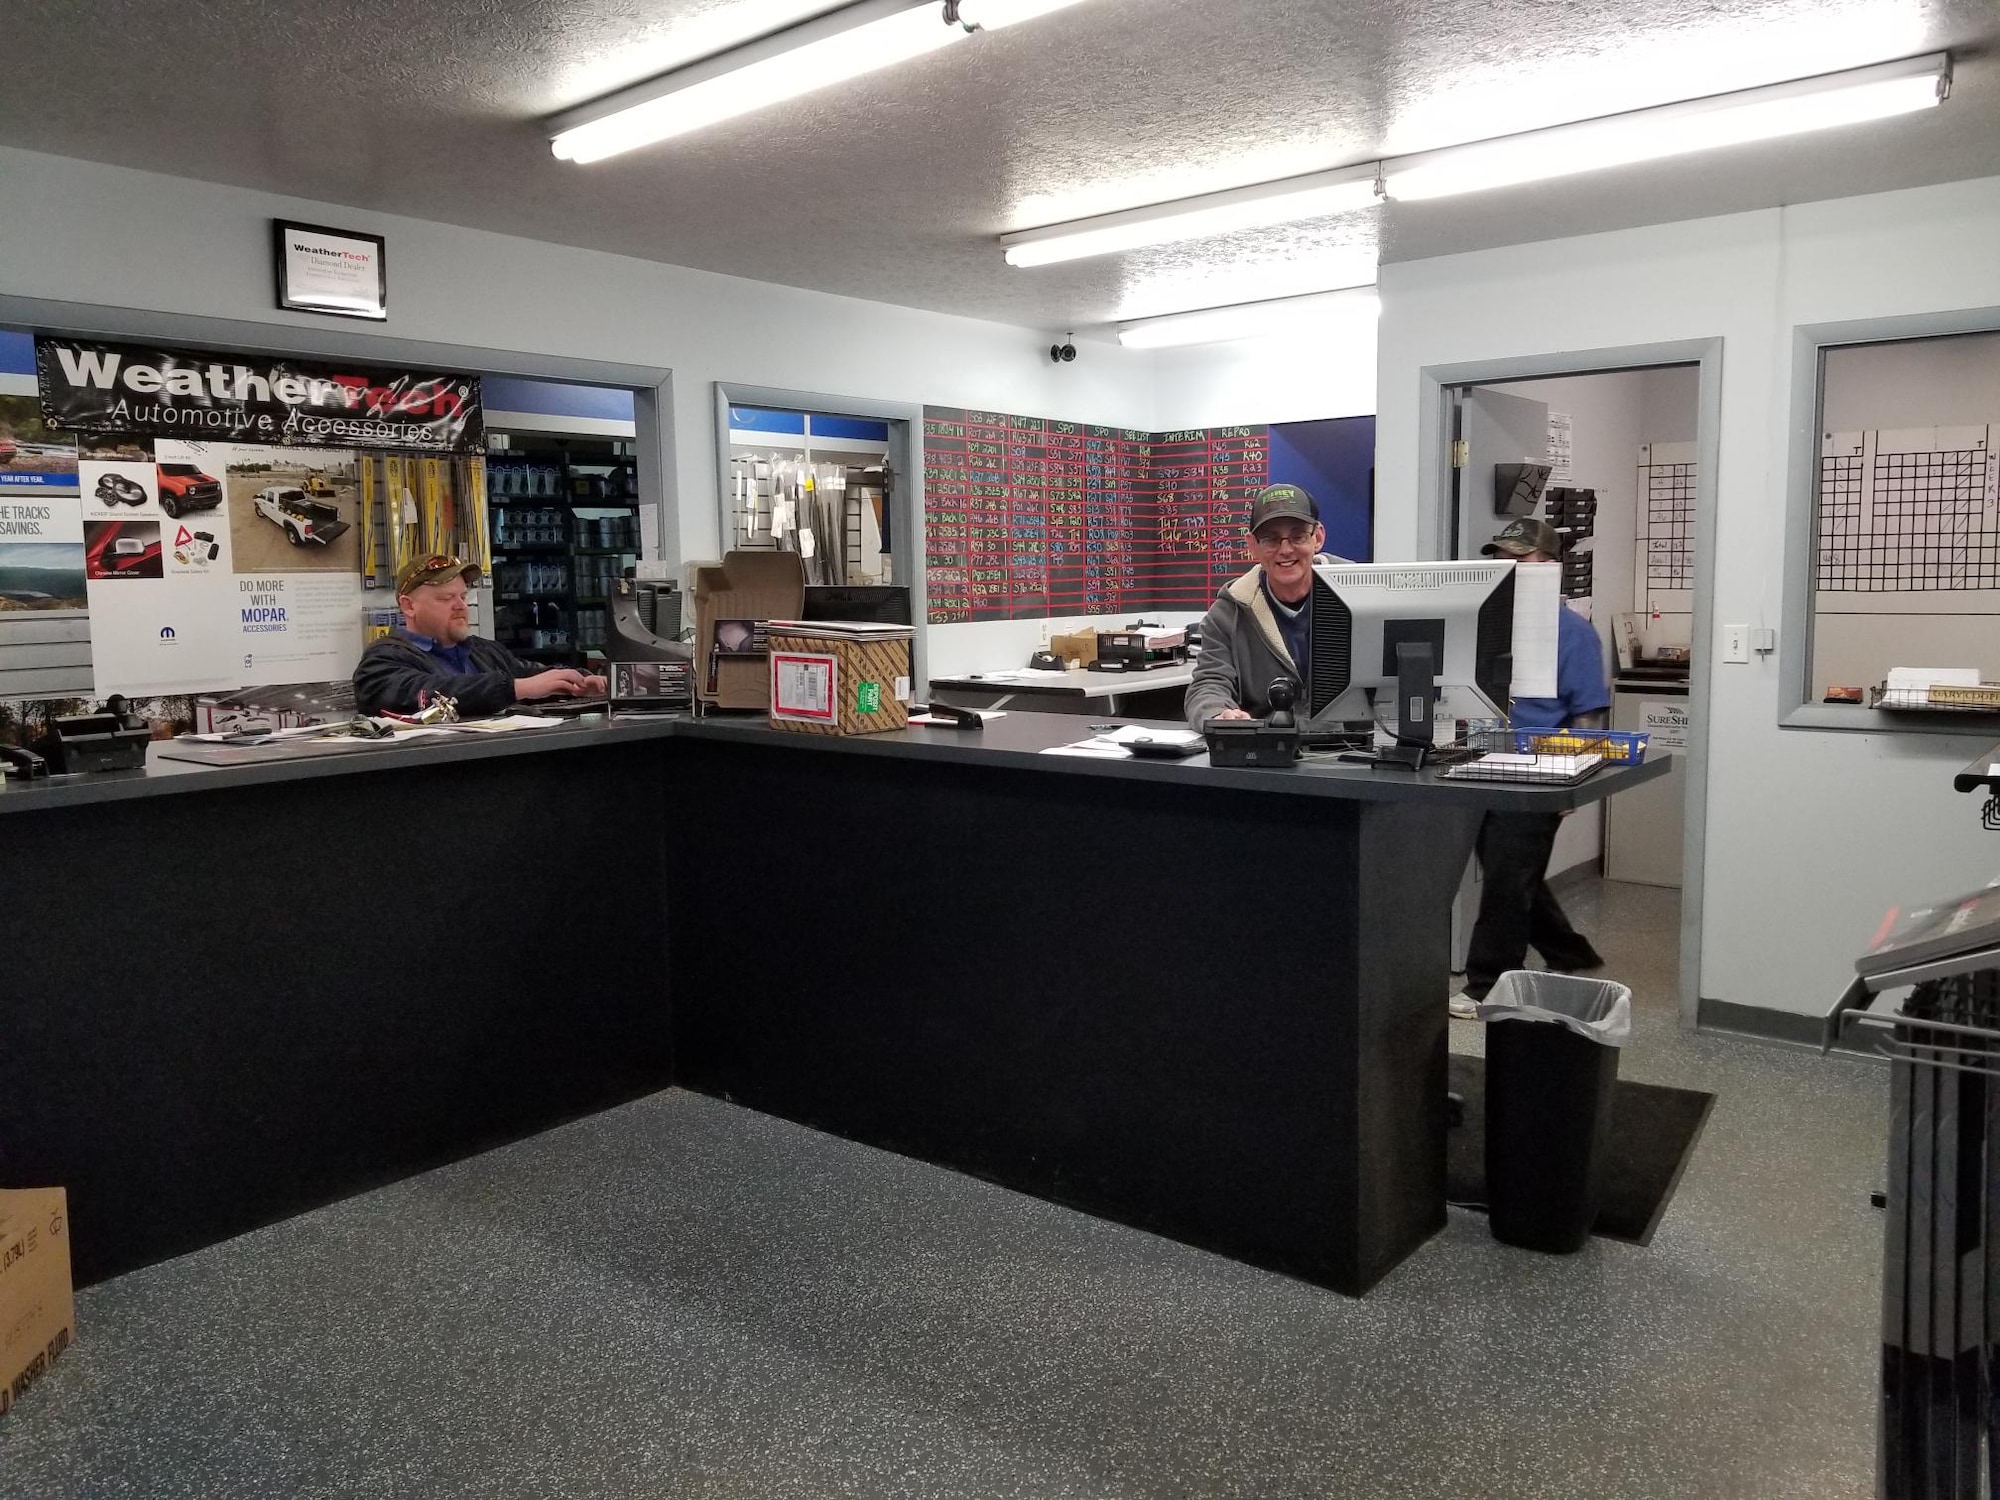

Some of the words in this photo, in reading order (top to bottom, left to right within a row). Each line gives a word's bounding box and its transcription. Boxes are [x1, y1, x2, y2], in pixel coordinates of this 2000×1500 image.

[111, 398, 272, 432] Automotive
[281, 406, 433, 441] Accessories
[1162, 430, 1205, 444] INTERIM
[1221, 427, 1250, 438] REPRO
[12, 506, 50, 520] TRACKS
[0, 521, 43, 536] SAVINGS.
[240, 581, 253, 592] DO
[256, 580, 284, 592] MORE
[250, 594, 276, 606] WITH
[242, 624, 287, 633] ACCESSORIES
[11, 1351, 46, 1401] WASHER
[48, 1327, 70, 1364] FLUID
